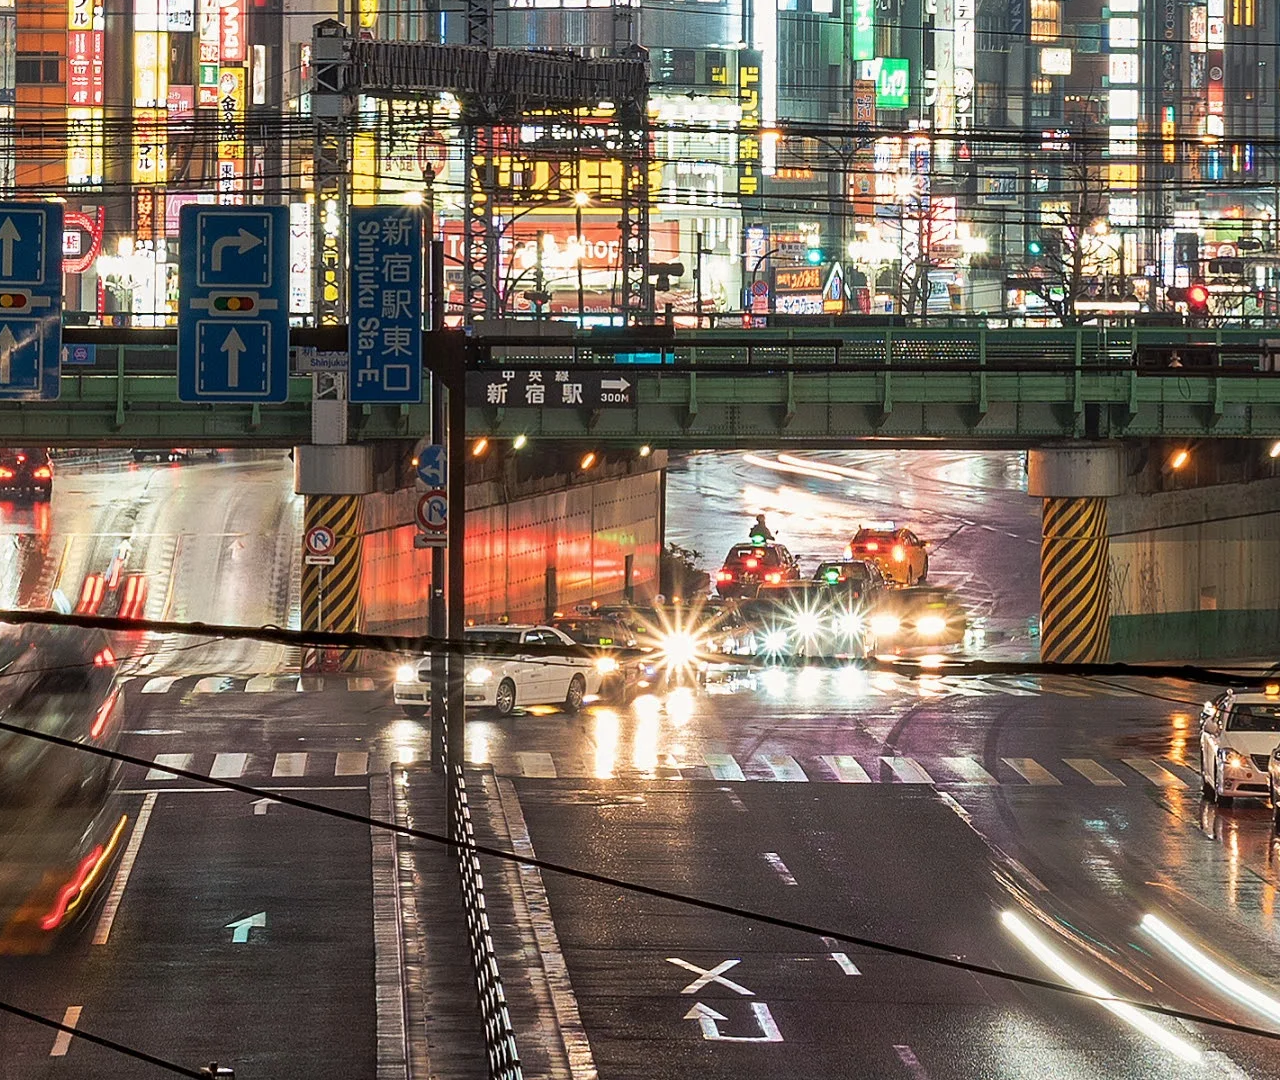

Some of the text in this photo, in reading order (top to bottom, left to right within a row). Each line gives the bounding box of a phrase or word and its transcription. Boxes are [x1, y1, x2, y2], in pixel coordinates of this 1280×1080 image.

[880, 67, 906, 97] レイク
[356, 220, 381, 388] Shinjuku Sta.-E.
[380, 216, 412, 392] 新宿駅東口
[486, 383, 583, 404] 新宿駅
[600, 392, 630, 404] 300M
